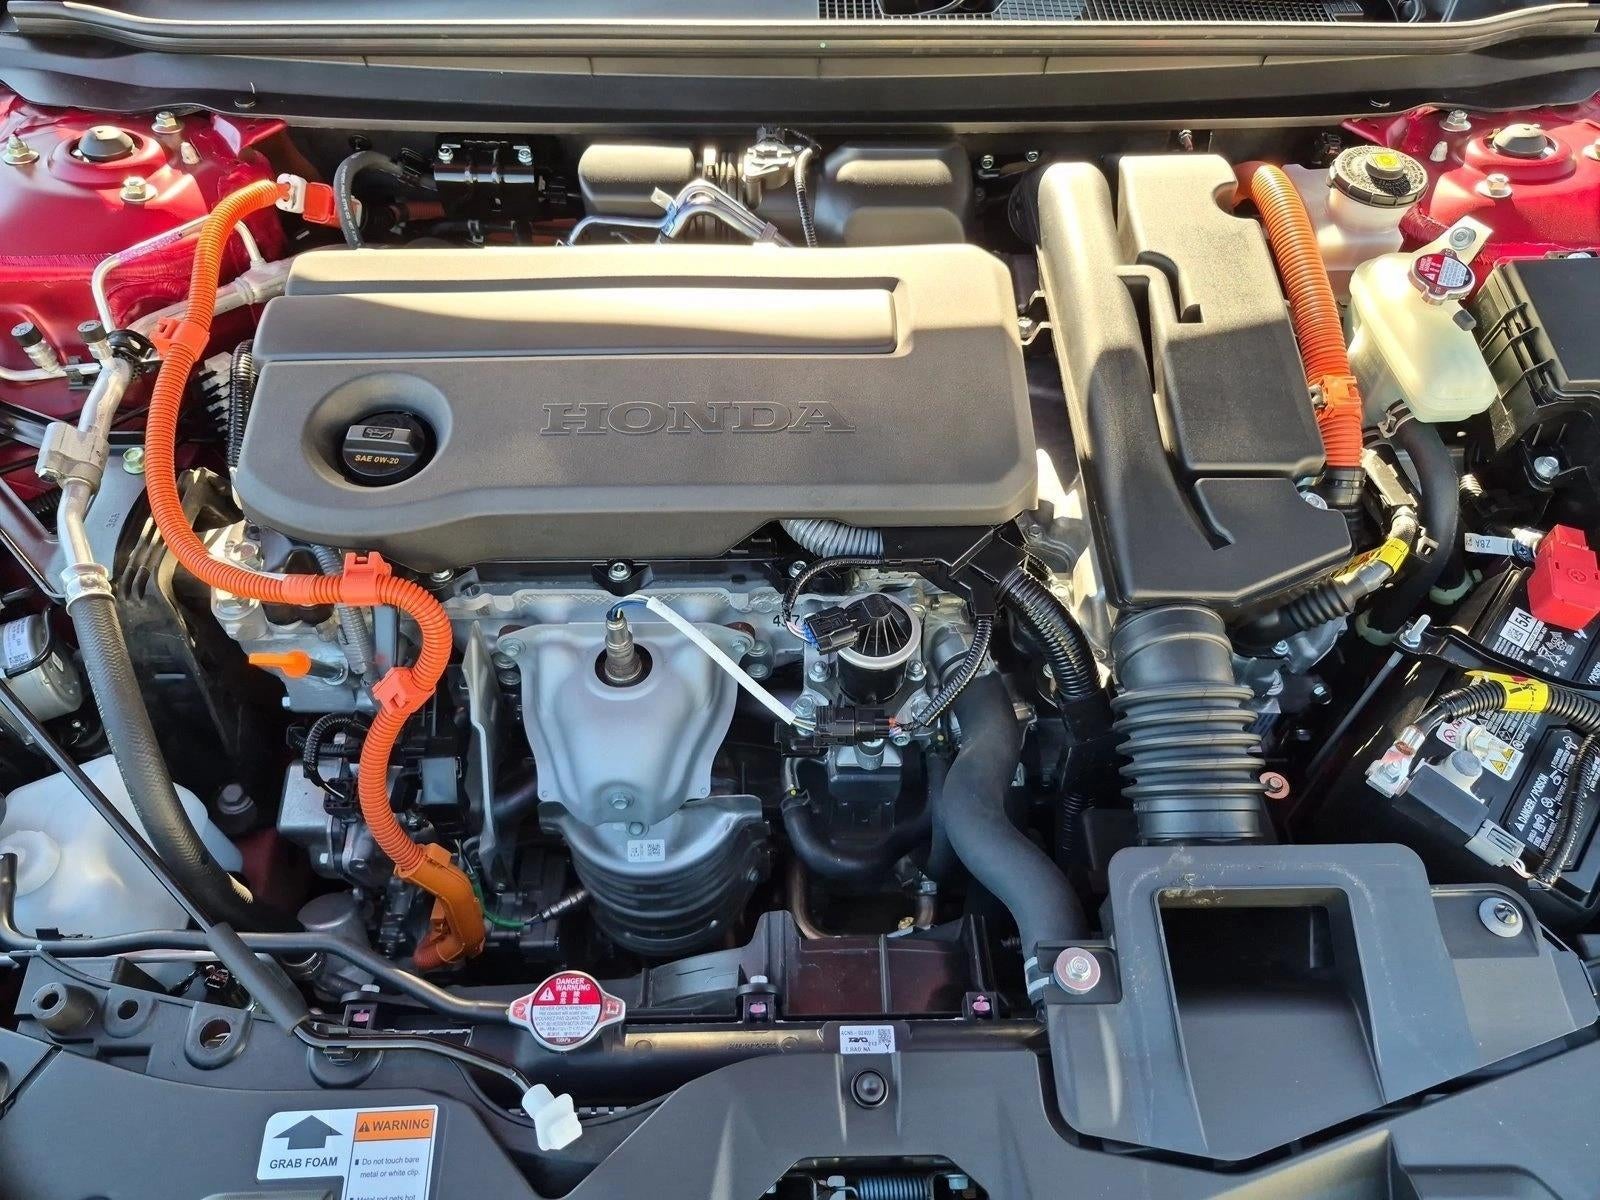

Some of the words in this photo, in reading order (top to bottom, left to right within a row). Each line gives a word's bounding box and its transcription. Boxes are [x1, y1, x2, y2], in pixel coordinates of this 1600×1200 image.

[540, 401, 856, 435] HONDA
[374, 456, 400, 465] 0W-20
[773, 614, 800, 627] 47
[1516, 610, 1533, 629] 5A
[1517, 798, 1537, 825] DANGER
[1531, 772, 1549, 797] POISON
[372, 1119, 430, 1132] WARNING
[269, 1158, 302, 1169] GRAB
[305, 1156, 338, 1168] FOAM
[385, 1156, 403, 1164] touch
